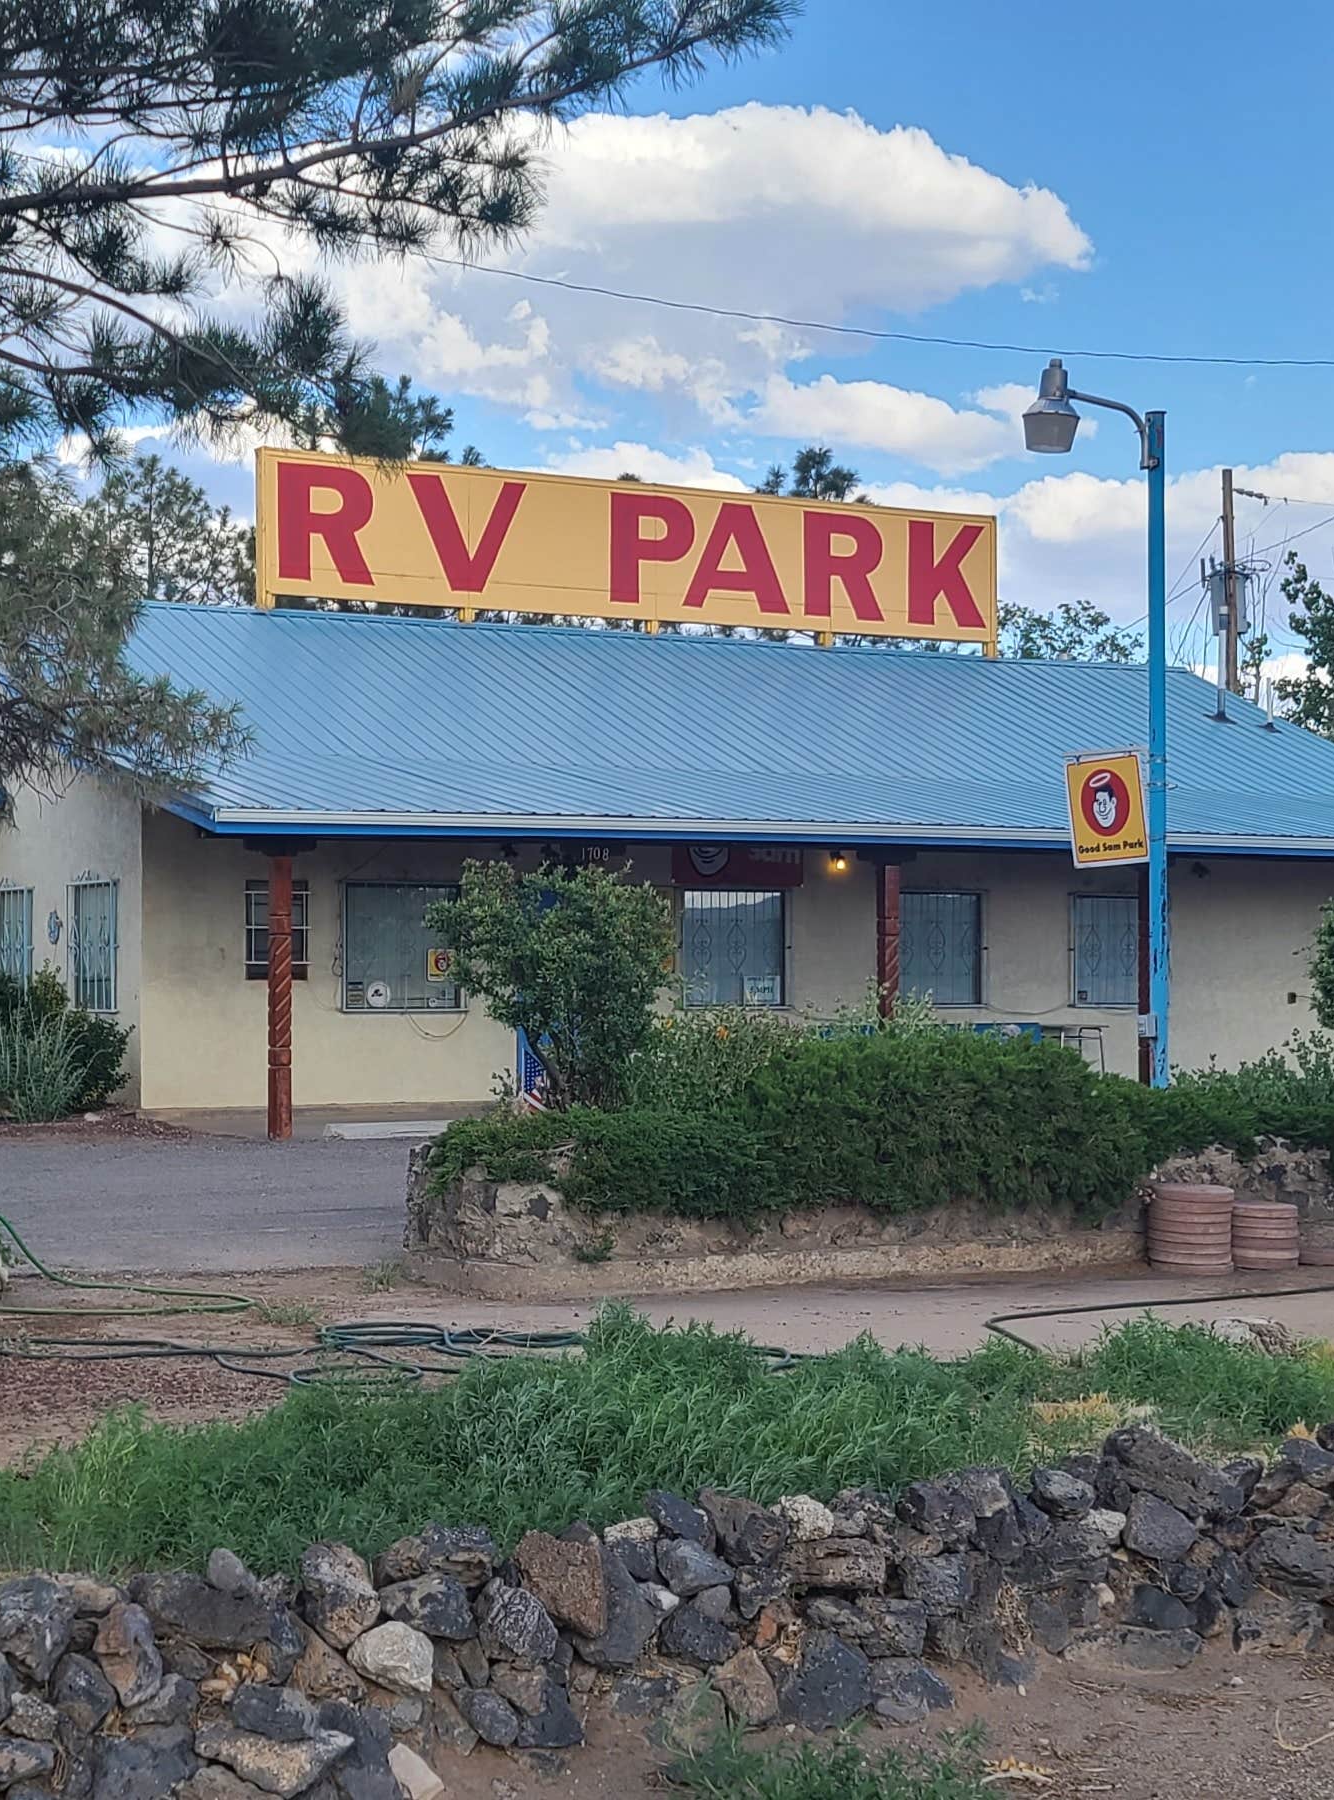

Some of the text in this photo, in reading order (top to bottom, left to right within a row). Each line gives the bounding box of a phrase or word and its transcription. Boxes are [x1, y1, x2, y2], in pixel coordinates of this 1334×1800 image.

[276, 461, 987, 629] RV PARK
[581, 846, 610, 862] 1708
[1078, 838, 1144, 855] Good Sam Park
